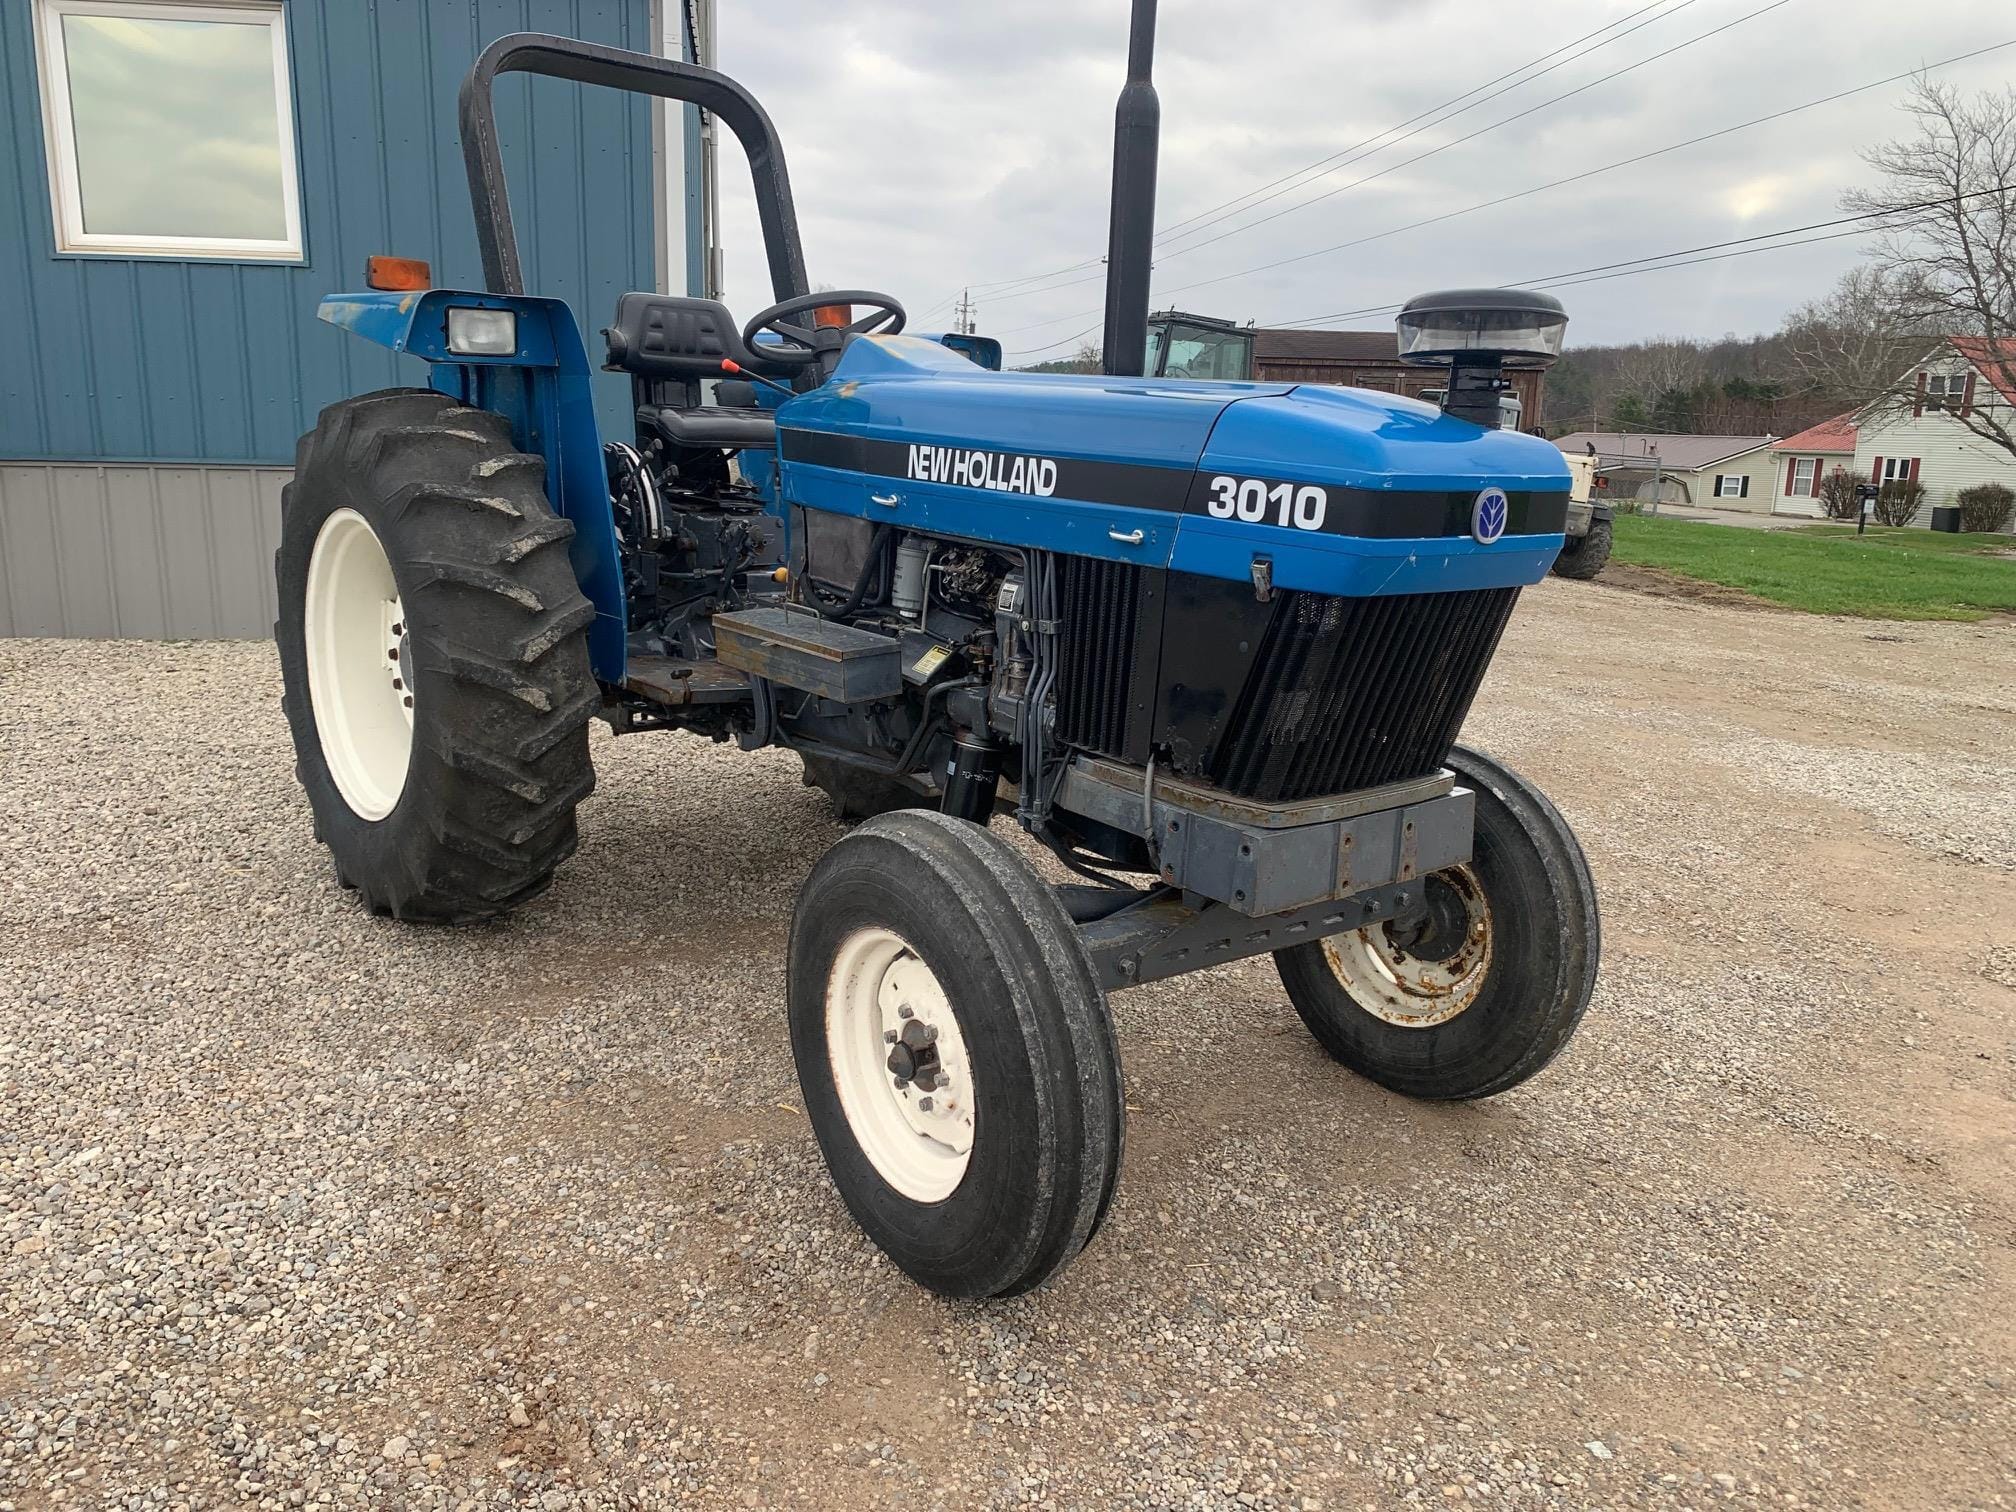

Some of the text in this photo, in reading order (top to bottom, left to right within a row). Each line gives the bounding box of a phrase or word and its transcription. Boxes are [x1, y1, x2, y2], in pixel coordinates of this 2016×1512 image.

[907, 444, 1058, 497] NEW HOLLAND
[1208, 476, 1327, 531] 3010
